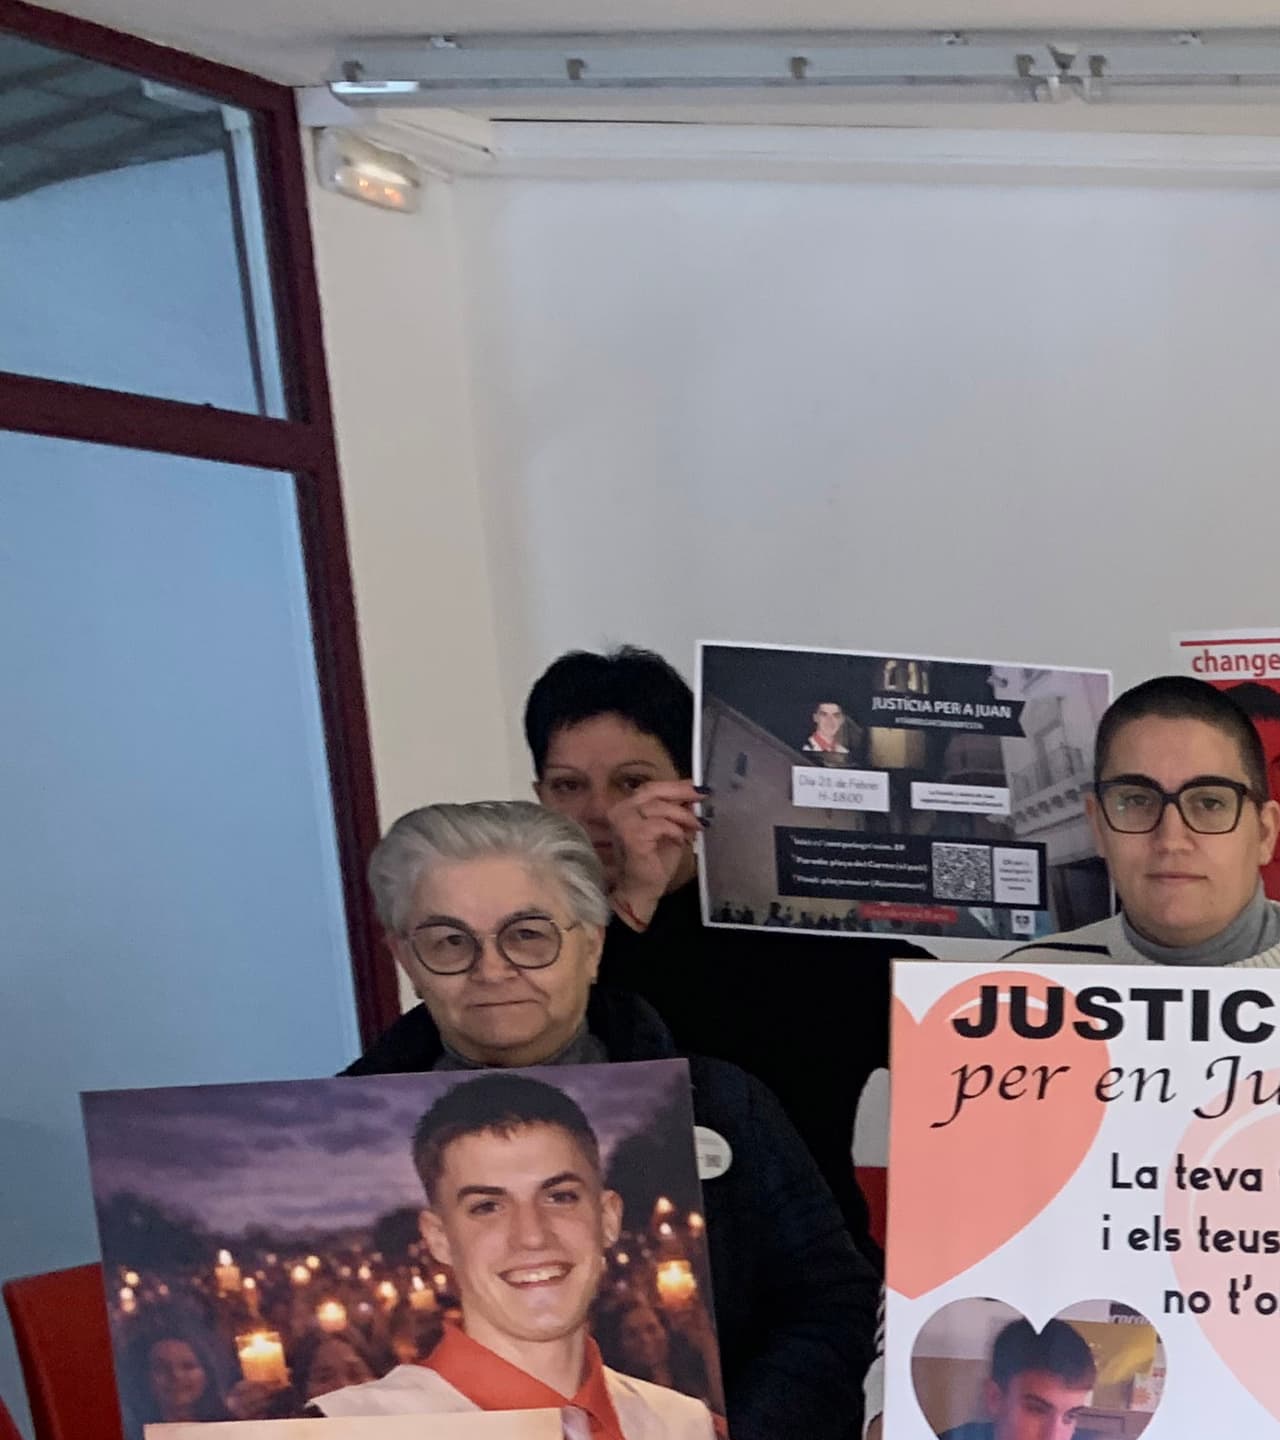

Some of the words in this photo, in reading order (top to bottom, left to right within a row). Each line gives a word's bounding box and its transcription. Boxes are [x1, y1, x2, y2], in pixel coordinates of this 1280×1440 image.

[872, 696, 933, 713] JUSTÍCIA
[934, 701, 960, 714] PER
[963, 704, 973, 716] A
[975, 704, 1012, 719] JUAN
[930, 1062, 1070, 1129] per
[1095, 1067, 1177, 1103] en
[1111, 1153, 1158, 1190] La
[1176, 1154, 1262, 1192] teva
[1101, 1214, 1111, 1251] i
[1128, 1216, 1181, 1252] els
[1199, 1217, 1280, 1254] teus
[1164, 1289, 1211, 1316] no
